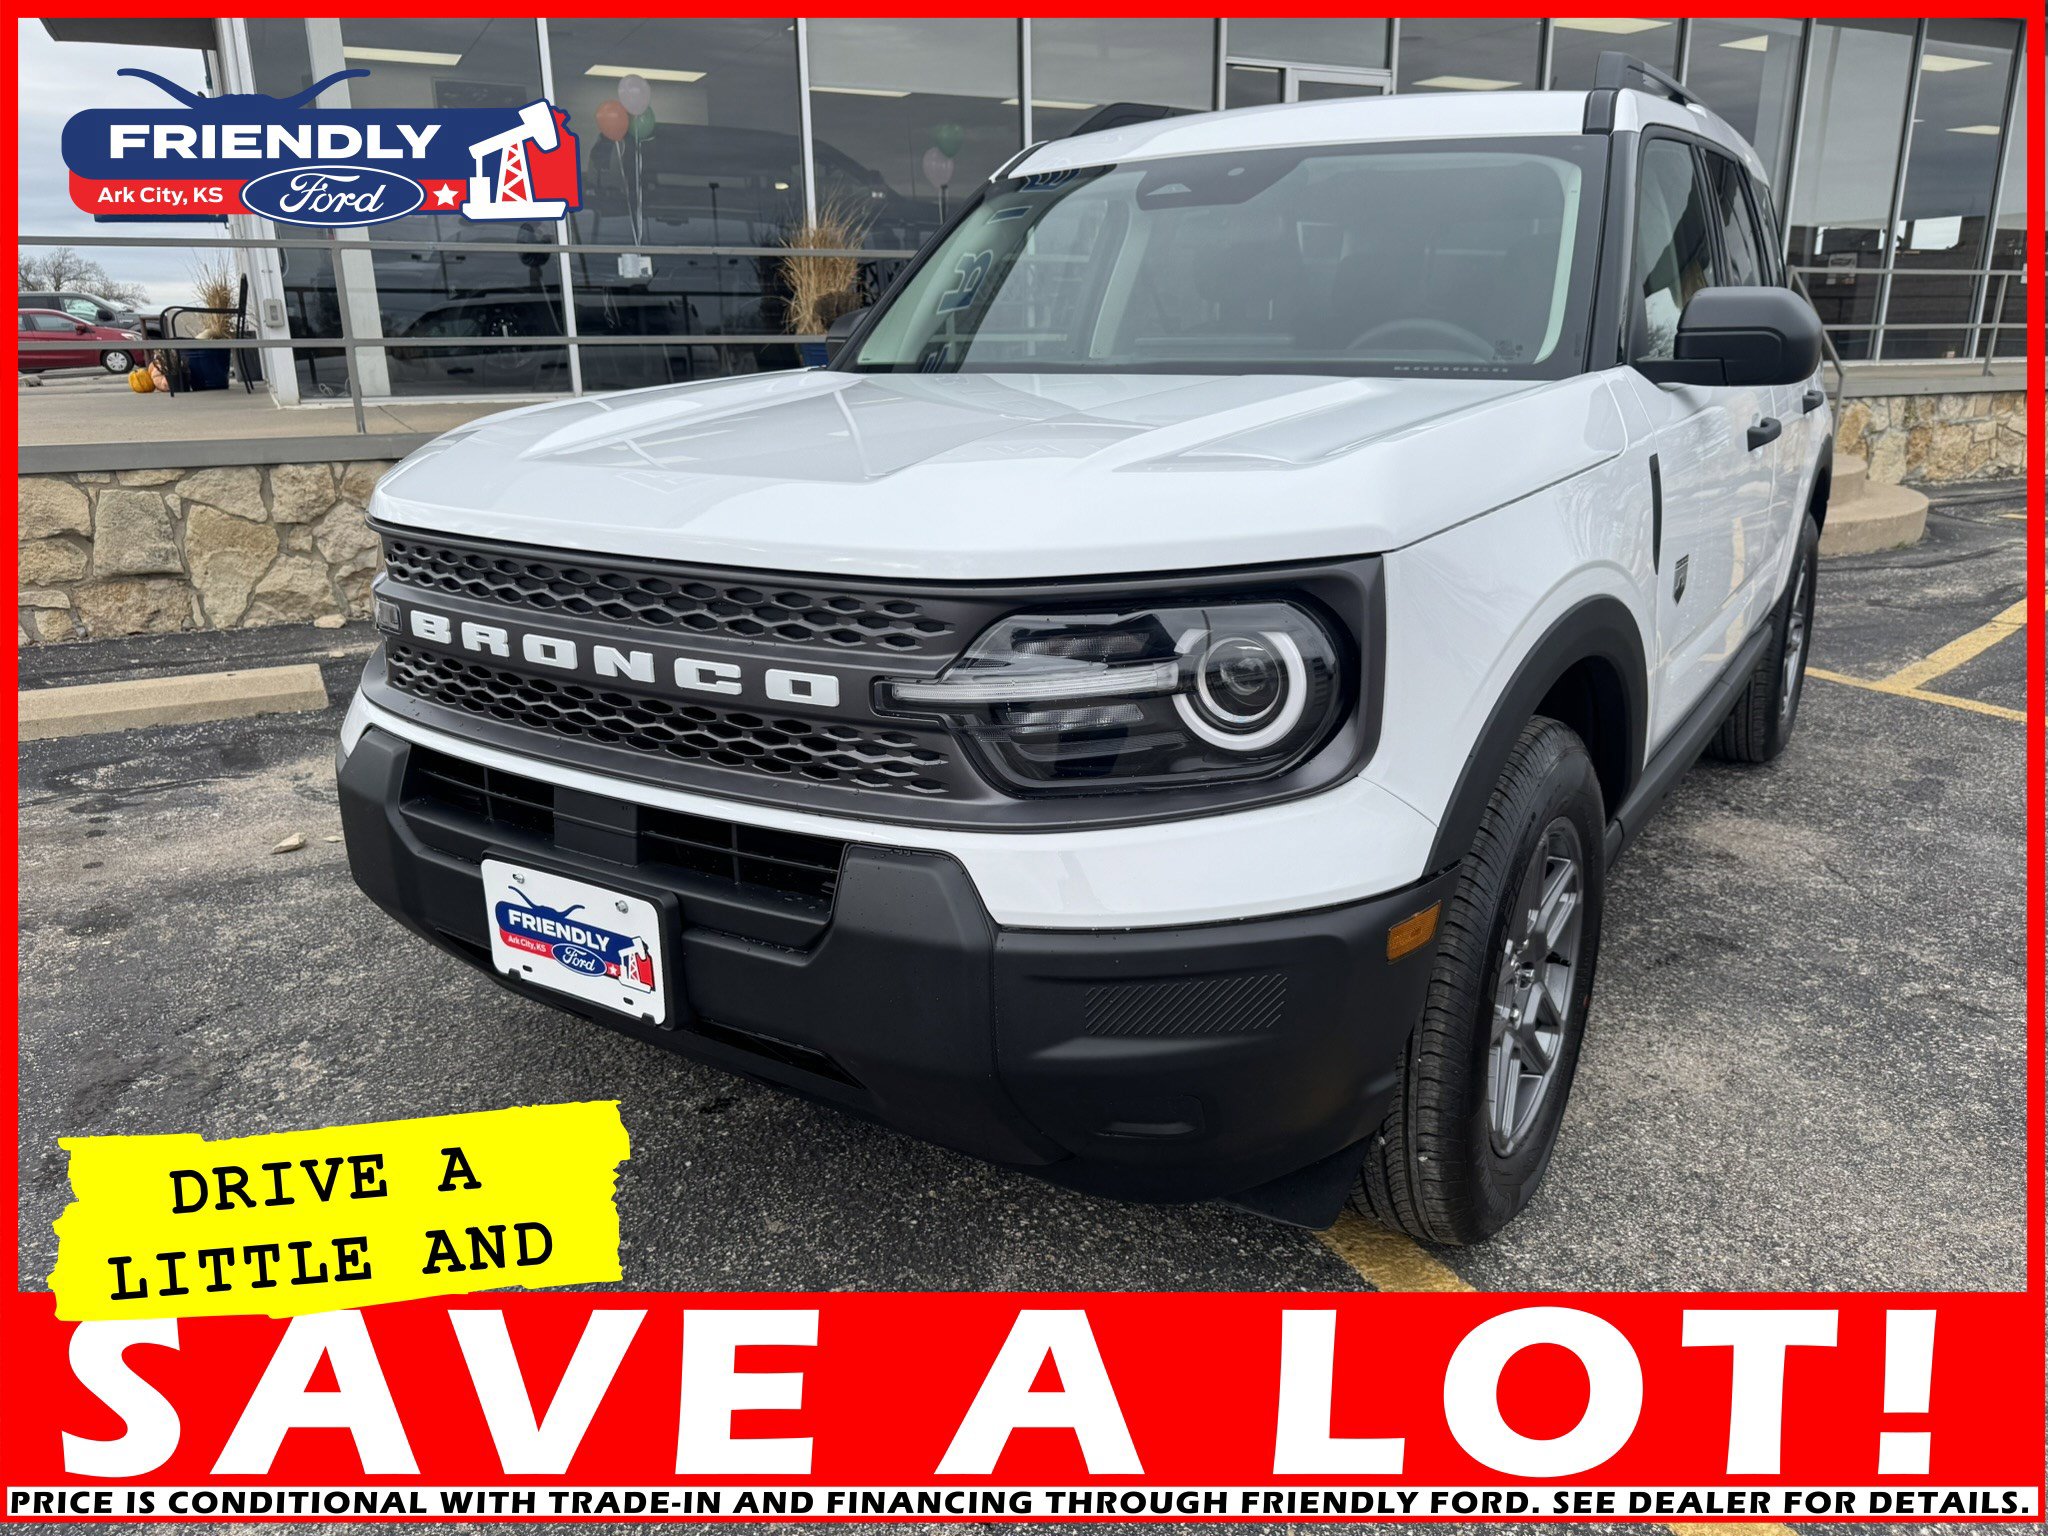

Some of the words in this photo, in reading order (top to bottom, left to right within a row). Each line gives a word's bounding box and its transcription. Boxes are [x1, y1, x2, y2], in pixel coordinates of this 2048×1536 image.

[409, 609, 840, 707] BRONCO
[508, 909, 610, 952] FRIENDLY
[508, 935, 521, 945] Ark
[520, 937, 537, 950] City,
[536, 943, 547, 952] KS
[562, 946, 596, 972] Ford
